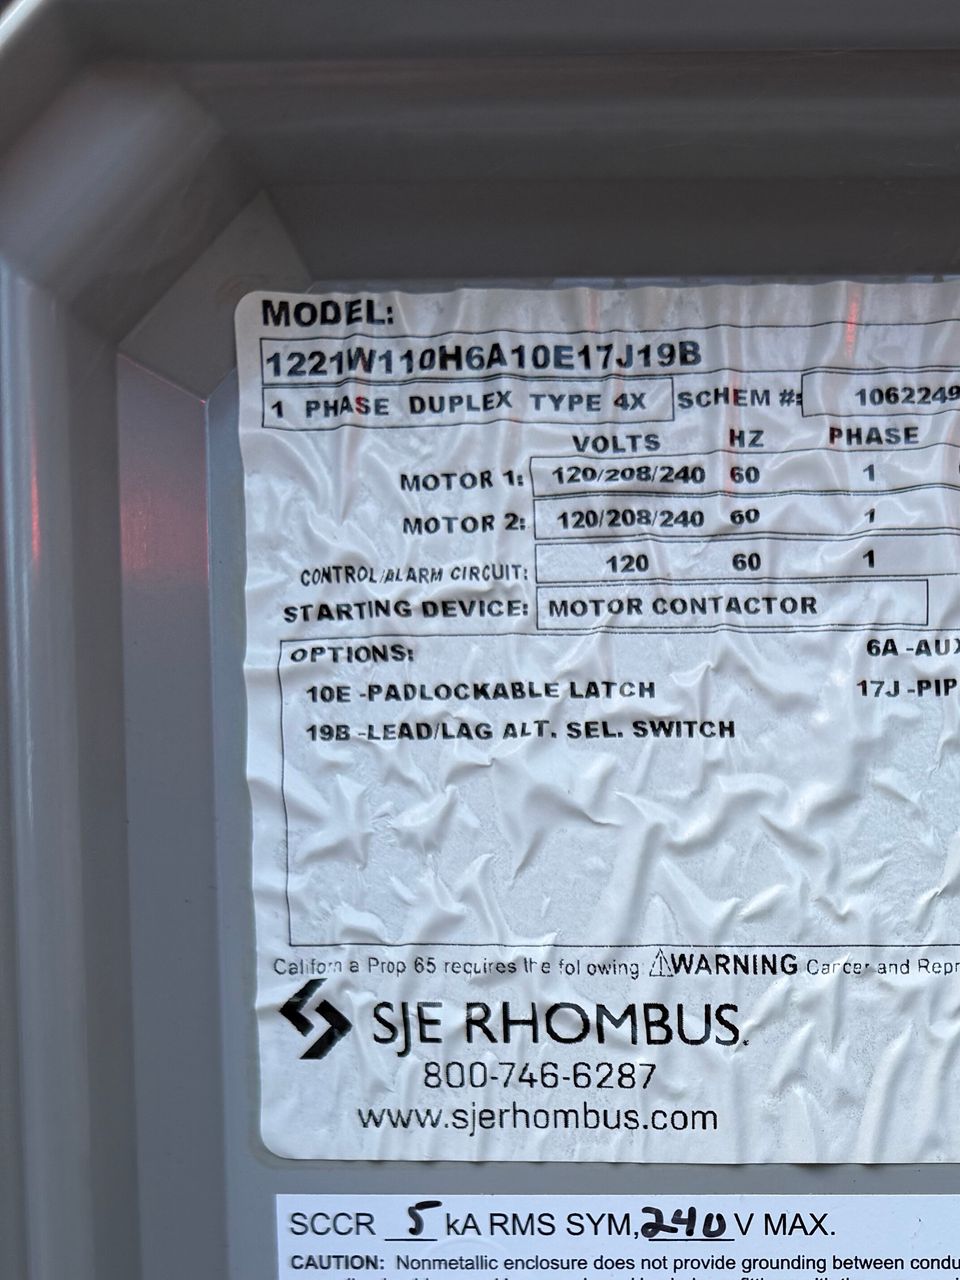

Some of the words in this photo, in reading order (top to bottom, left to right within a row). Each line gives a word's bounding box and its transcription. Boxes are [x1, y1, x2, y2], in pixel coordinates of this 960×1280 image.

[261, 298, 394, 328] MODEL:
[266, 340, 701, 377] 1221W110H6A10E17J19B
[271, 400, 284, 418] 1
[305, 394, 389, 418] PHASE
[408, 390, 513, 415] DUPLEX
[529, 393, 602, 412] TYPE
[613, 392, 646, 411] 4X
[677, 386, 771, 410] SCHEM
[571, 433, 661, 454] VOLTS
[729, 428, 764, 448] HZ
[829, 426, 919, 446] PHASE
[400, 469, 494, 492] MOTOR
[502, 469, 524, 487] 1:
[551, 465, 706, 485] 120/208/240
[729, 465, 760, 484] 60
[862, 463, 875, 482] 1
[300, 564, 443, 587] CONTROL/ALARM
[450, 562, 528, 582] CIRCUIT:
[606, 553, 650, 573] 120
[732, 552, 762, 571] 60
[862, 549, 875, 568] 1
[283, 599, 412, 623] STARTING
[421, 598, 528, 618] DEVICE:
[548, 597, 643, 618] MOTOR
[651, 595, 818, 616] CONTACTOR
[290, 643, 414, 664] OPTIONS:
[866, 638, 899, 657] 6A
[306, 685, 351, 703] 10E
[569, 680, 655, 699] LATCH
[306, 724, 351, 741] 19B
[502, 719, 557, 740] ALT.
[566, 720, 624, 739] SEL.
[632, 717, 735, 738] SWITCH
[670, 953, 798, 976] WARNING
[373, 1001, 443, 1058] SJE
[423, 1061, 657, 1090] 800-746-6287
[357, 1100, 718, 1137] www.sjerhombus.com
[290, 1212, 377, 1236] SCCR
[446, 1212, 482, 1236] kA
[489, 1212, 556, 1236] RMS
[640, 1206, 727, 1239] 240
[733, 1212, 755, 1236] V
[764, 1212, 836, 1236] MAX.
[290, 1254, 385, 1270] CAUTION:
[396, 1254, 499, 1271] Nonmetallic
[503, 1254, 588, 1271] enclosure
[593, 1254, 636, 1270] does
[640, 1255, 669, 1270] not
[673, 1254, 737, 1274] provide
[741, 1254, 827, 1274] grounding
[832, 1254, 905, 1270] between
